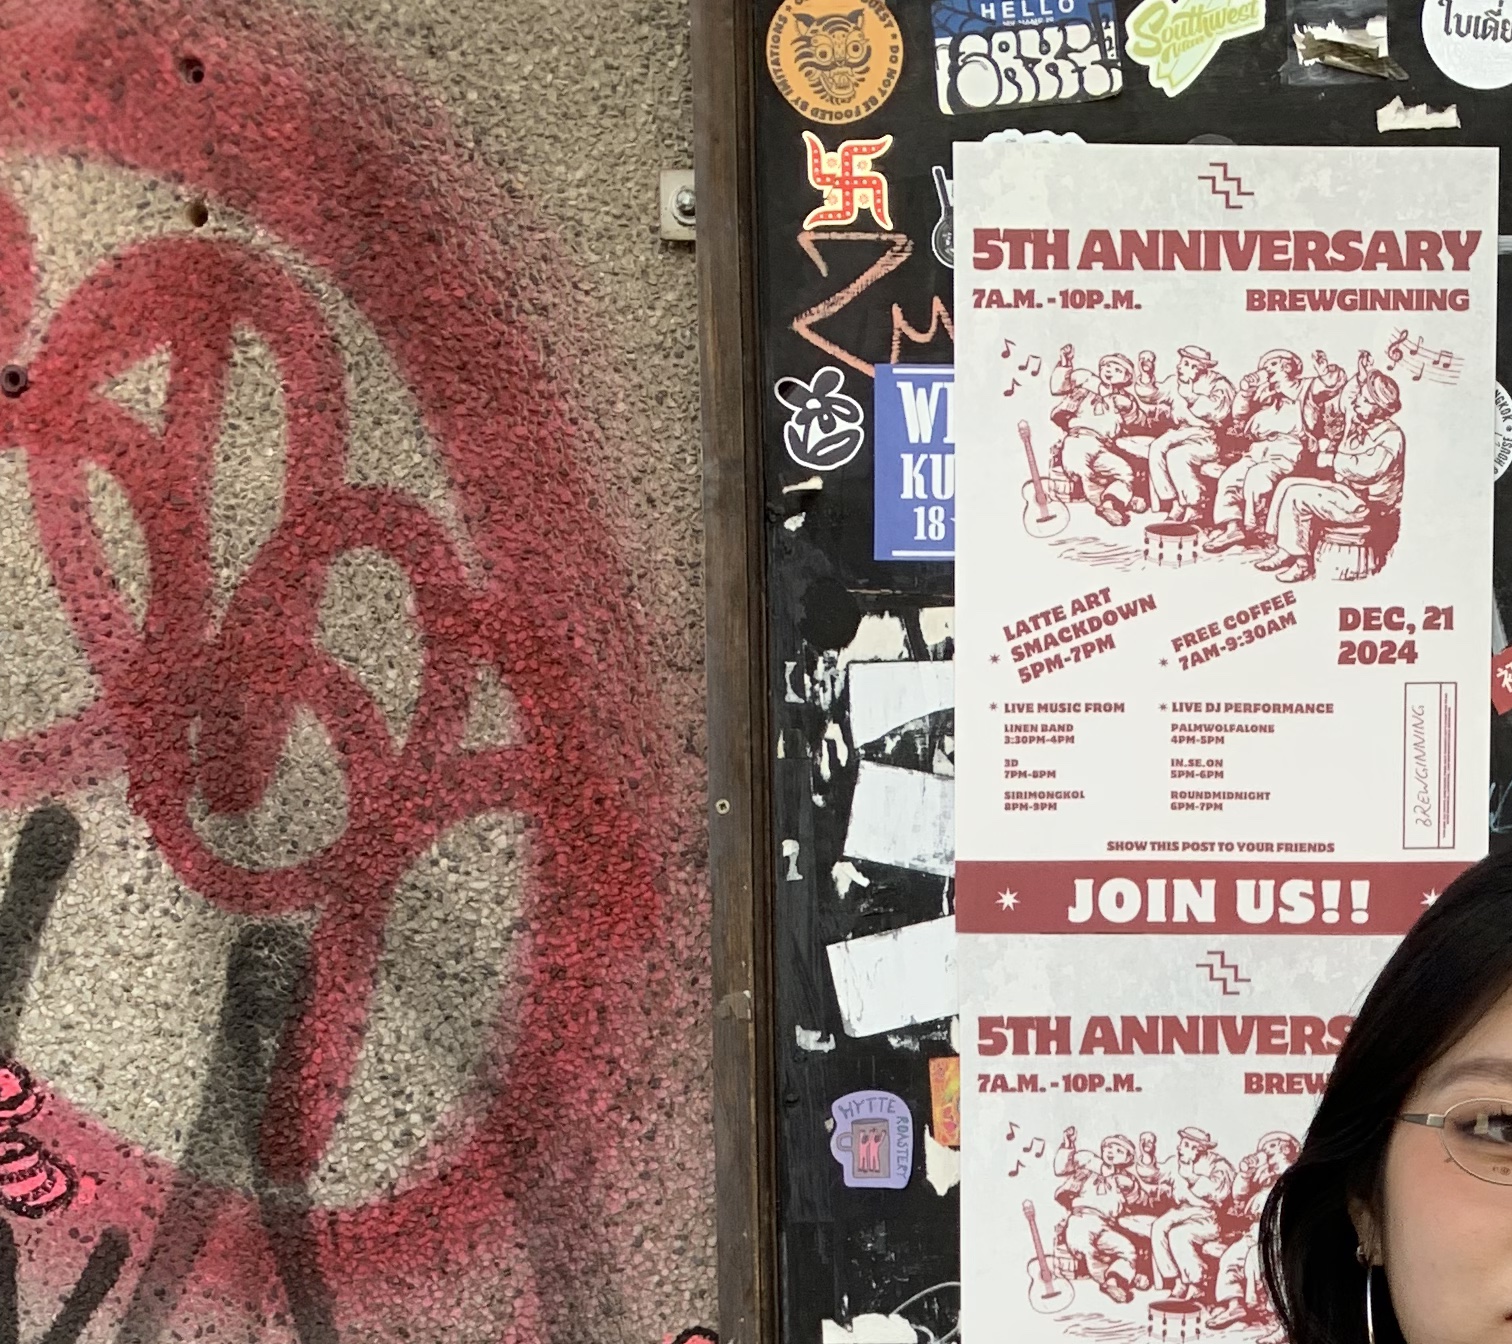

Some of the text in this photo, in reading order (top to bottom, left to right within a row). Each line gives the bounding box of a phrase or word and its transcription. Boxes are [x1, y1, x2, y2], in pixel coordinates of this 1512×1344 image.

[980, 0, 1076, 20] HELLO
[769, 14, 795, 96] IMITATIONS
[972, 227, 1483, 273] 5TH ANNIVERSARY
[971, 288, 1143, 310] 7A.M. 10P.M.
[1245, 288, 1470, 312] BREWGINNING
[1003, 586, 1112, 643] LATTE ART
[1170, 590, 1298, 654] FREE COFFEE
[1338, 605, 1454, 635] DEC, 21
[1010, 594, 1158, 664] SMACKDOWN
[1178, 611, 1298, 672] 7AM-9:30AM
[1337, 639, 1419, 666] 2024
[1017, 633, 1117, 685] 5PM-7PM
[1004, 702, 1125, 714] LIVE MUSIC FROM
[1171, 701, 1334, 714] LIVE DJ PERFORMANCE
[1004, 723, 1074, 733] LINEN BAND
[1170, 723, 1275, 734] PALMWOLFALONE
[1170, 735, 1225, 745] 4PM-5PM
[1170, 769, 1225, 780] 5PM-6PM
[1003, 790, 1086, 801] SIRIMONGKOL
[1170, 790, 1271, 801] ROUNDMIDNIGHT
[1170, 801, 1223, 811] 6PM-7PM
[1106, 840, 1335, 853] SHOW THIS POST TO YOUR FRIENDS
[1067, 877, 1371, 925] JOIN US!!
[977, 1015, 1073, 1057] 5TH
[896, 1115, 911, 1181] ROASTERY
